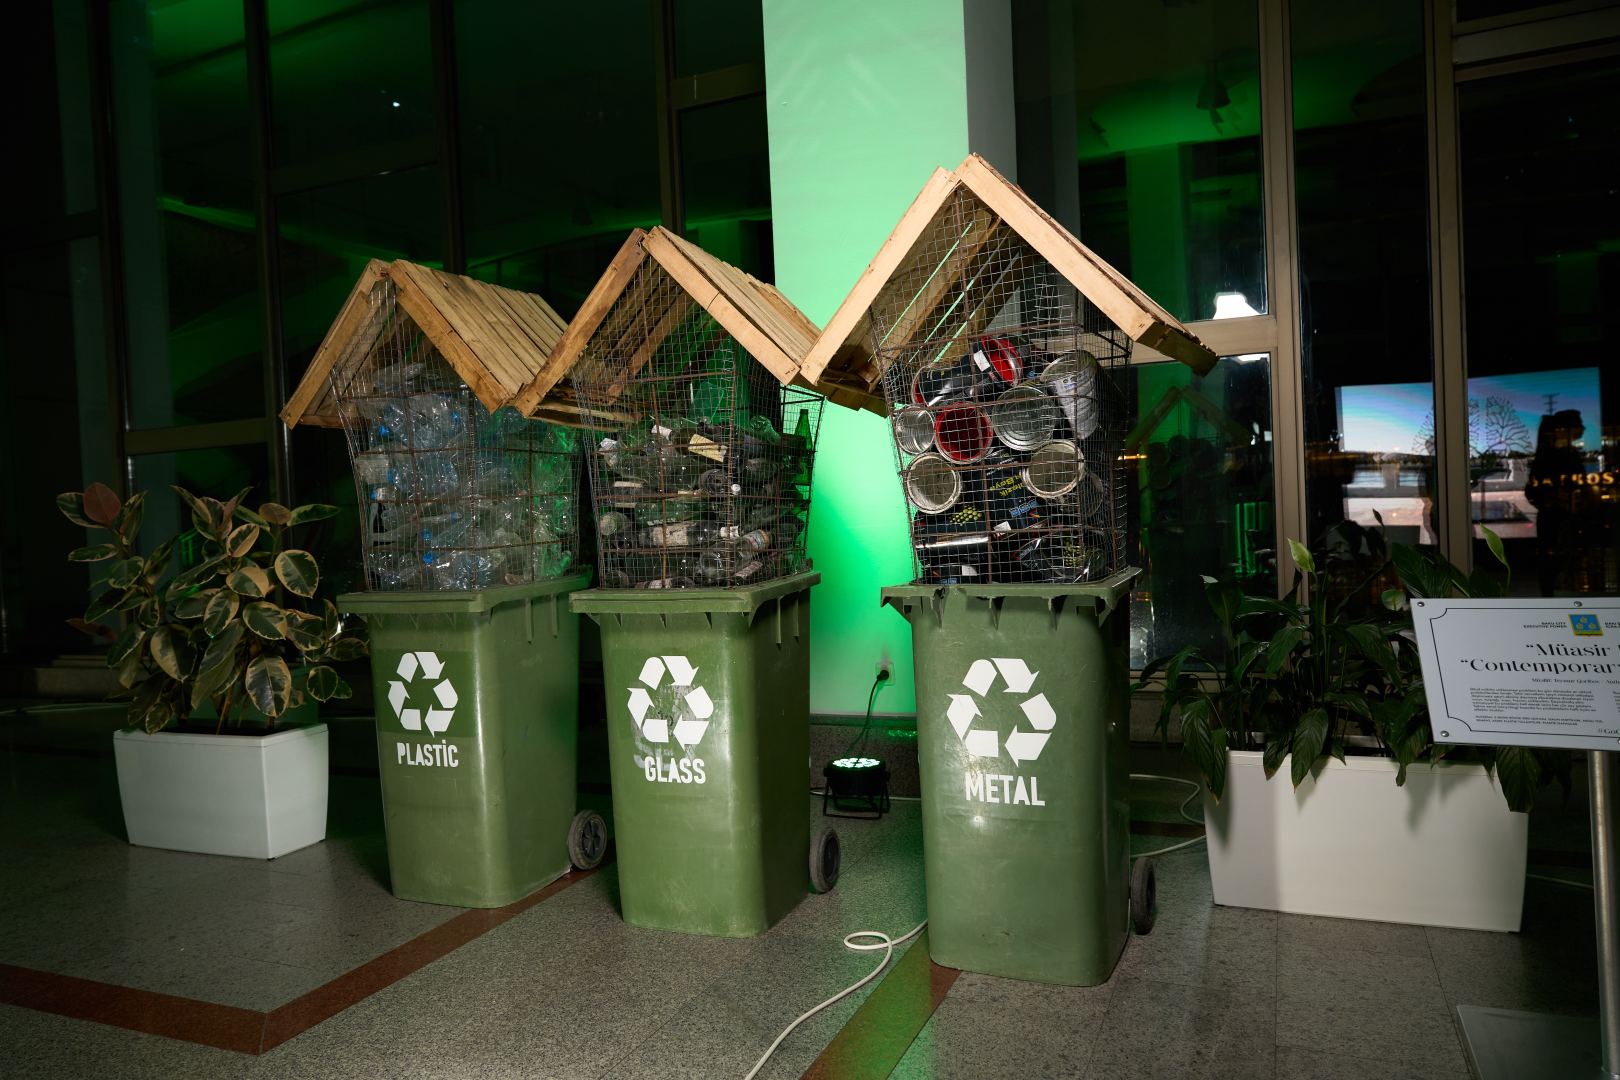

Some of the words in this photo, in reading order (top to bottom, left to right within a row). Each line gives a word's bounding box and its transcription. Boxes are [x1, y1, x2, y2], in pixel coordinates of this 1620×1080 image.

[1460, 658, 1620, 674] “Contemporar
[644, 755, 707, 785] GLASS
[964, 771, 1046, 807] METAL
